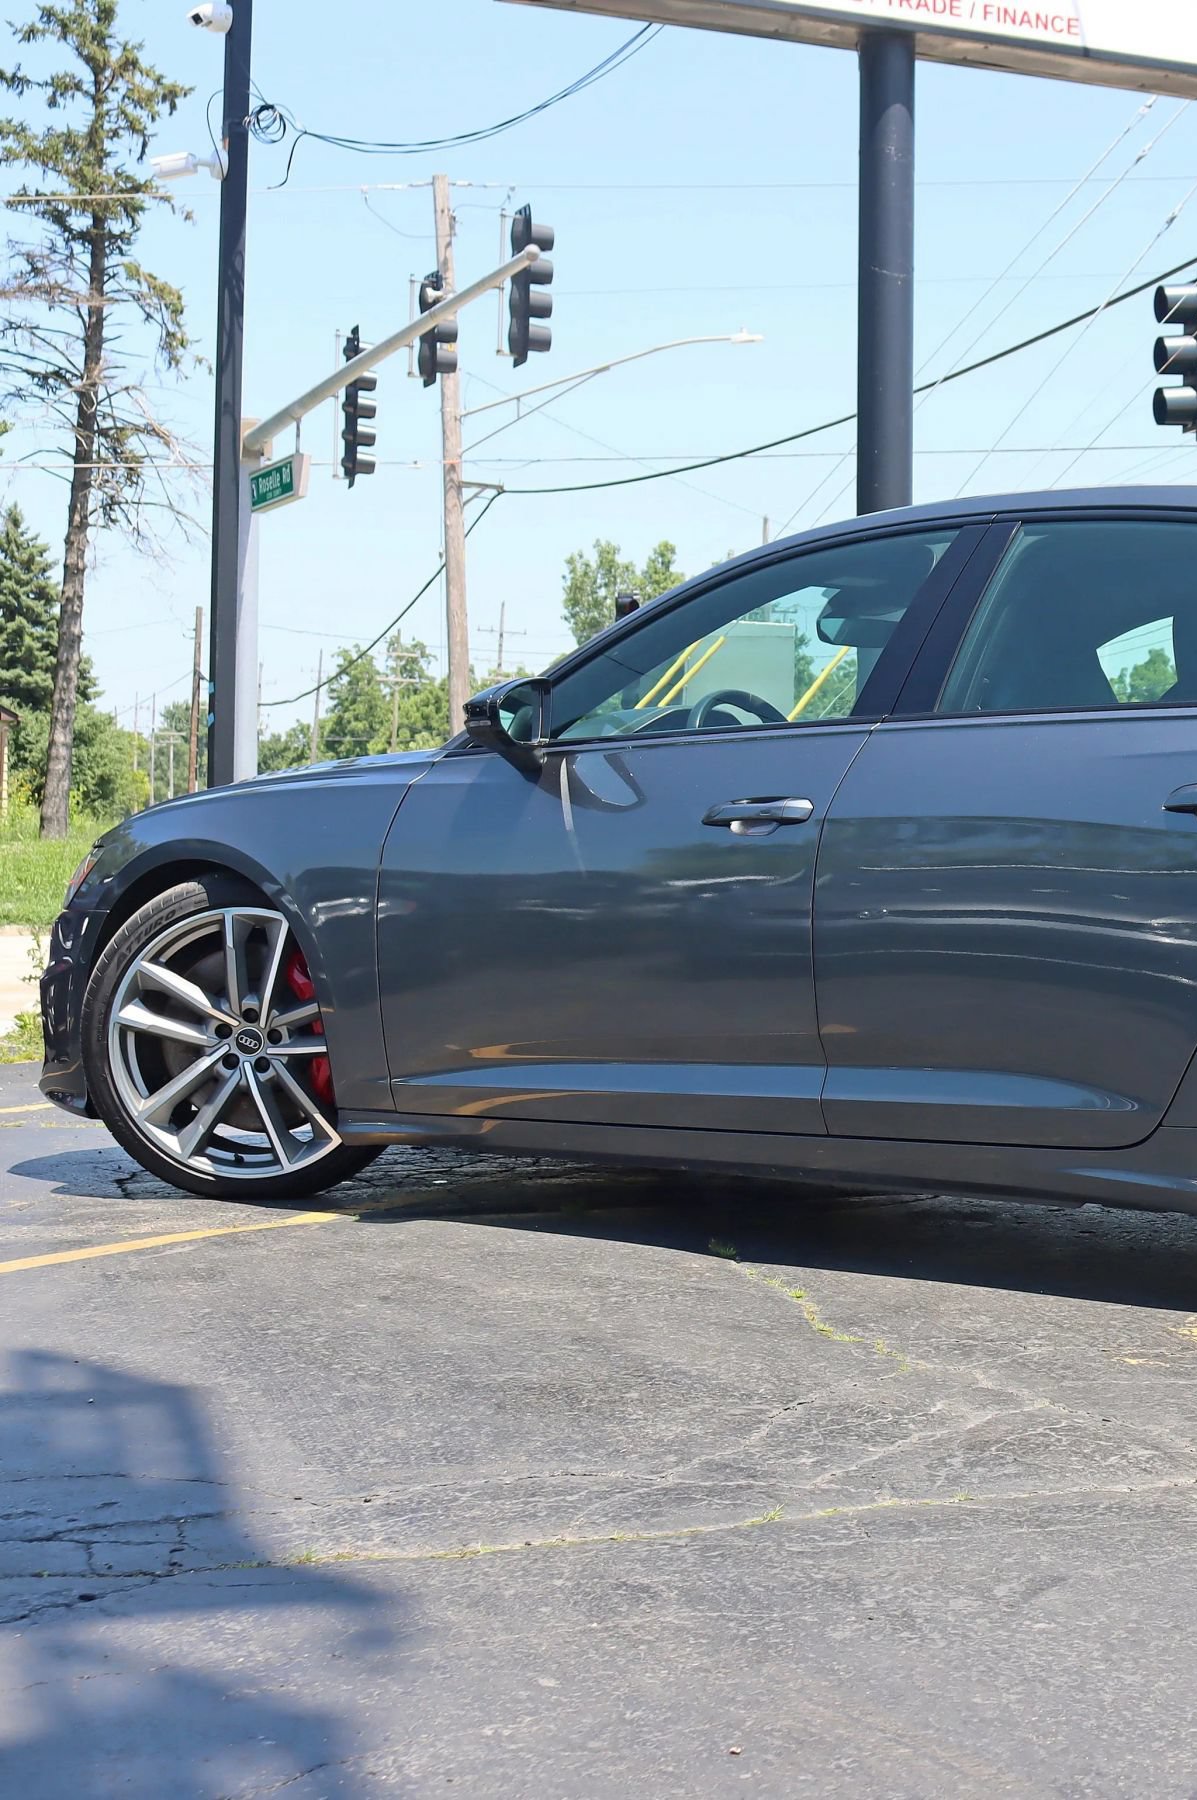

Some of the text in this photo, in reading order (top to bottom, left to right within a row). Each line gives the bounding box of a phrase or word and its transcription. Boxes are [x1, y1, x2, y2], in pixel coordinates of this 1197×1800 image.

[969, 2, 976, 19] /
[982, 3, 1080, 36] FINANCE
[258, 470, 281, 494] Roselle
[282, 464, 291, 484] Rd
